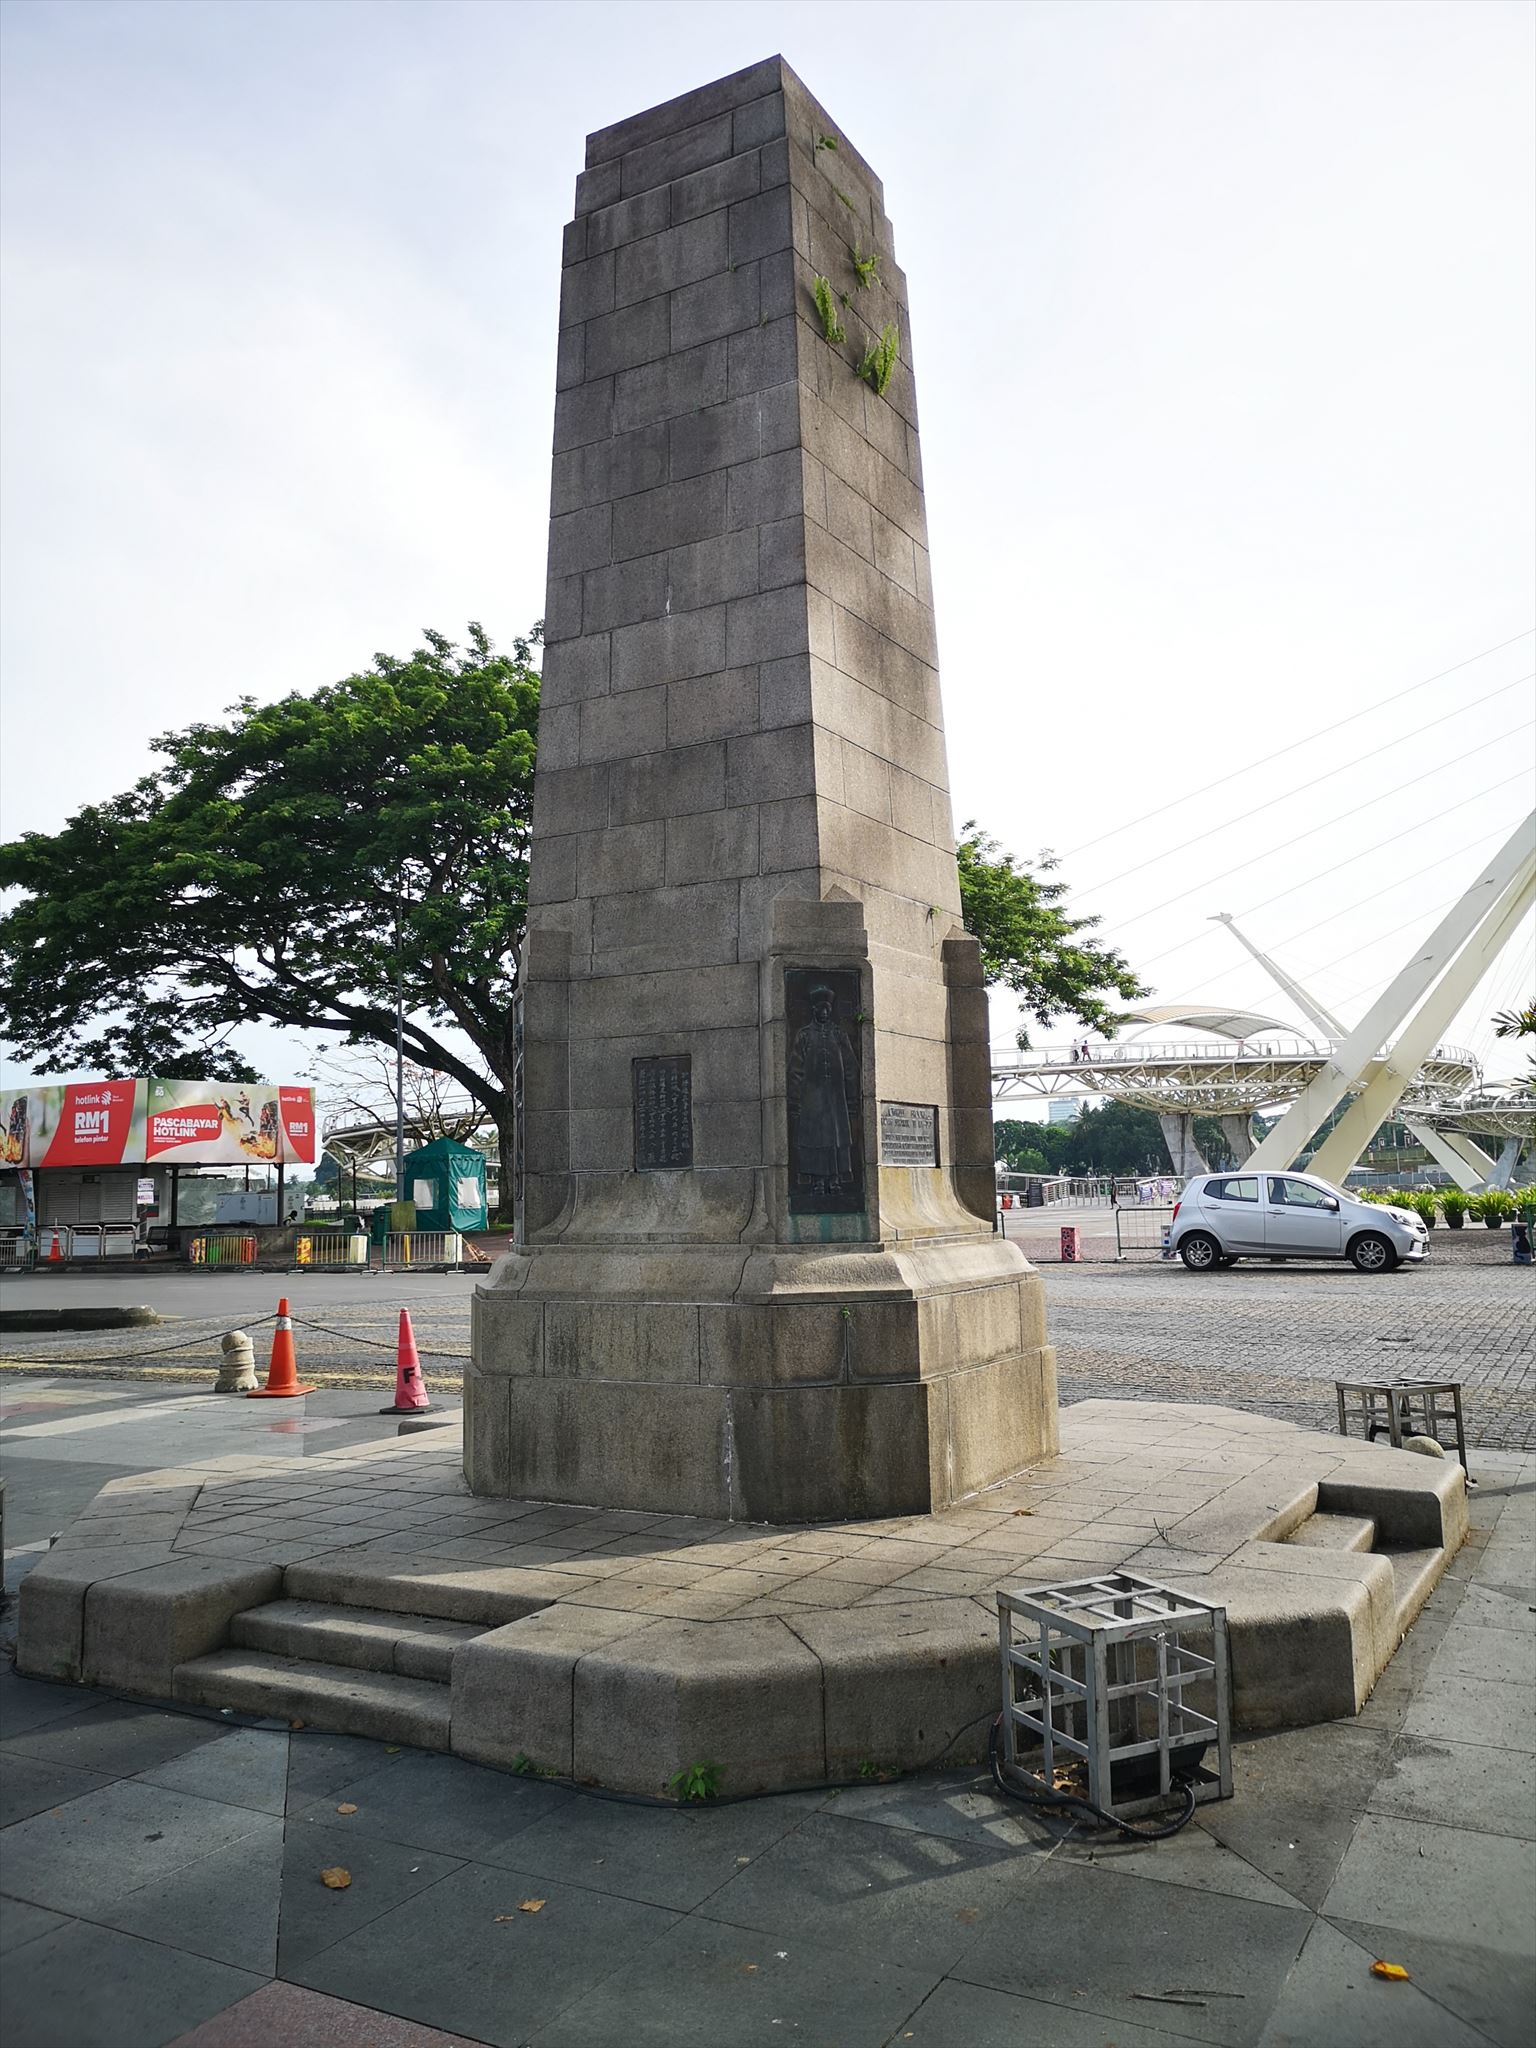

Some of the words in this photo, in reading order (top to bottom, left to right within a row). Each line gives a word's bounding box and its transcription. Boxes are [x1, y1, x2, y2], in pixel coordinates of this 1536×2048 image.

[75, 1095, 100, 1104] hotlink
[75, 1110, 109, 1133] RM1
[153, 1117, 218, 1128] PASCABAYAR
[153, 1127, 197, 1137] HOTLINK
[289, 1122, 308, 1133] RM1
